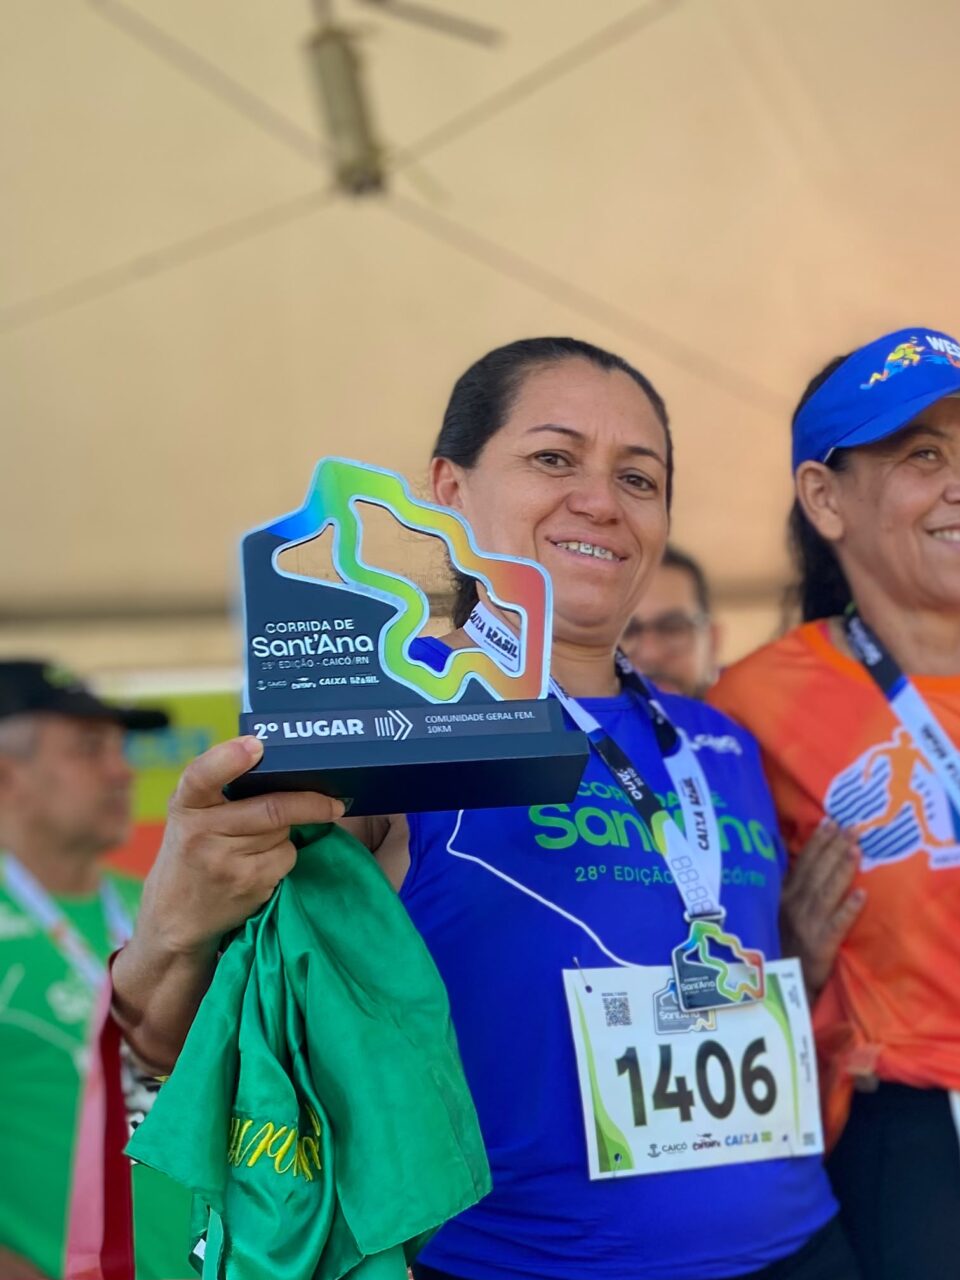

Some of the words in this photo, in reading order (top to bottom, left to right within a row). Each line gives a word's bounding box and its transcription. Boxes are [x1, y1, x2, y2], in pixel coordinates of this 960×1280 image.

[265, 621, 332, 634] CORRIDA
[334, 619, 355, 631] DE
[252, 633, 375, 658] Sant'Ana
[319, 677, 347, 686] CAIXA
[283, 719, 365, 739] LUGAR
[425, 713, 484, 724] COMUNIDADE
[486, 712, 513, 721] GERAL
[427, 725, 452, 734] 10KM
[692, 812, 710, 851] CAIXA
[615, 1036, 777, 1127] 1406
[725, 1133, 759, 1147] CAIXA
